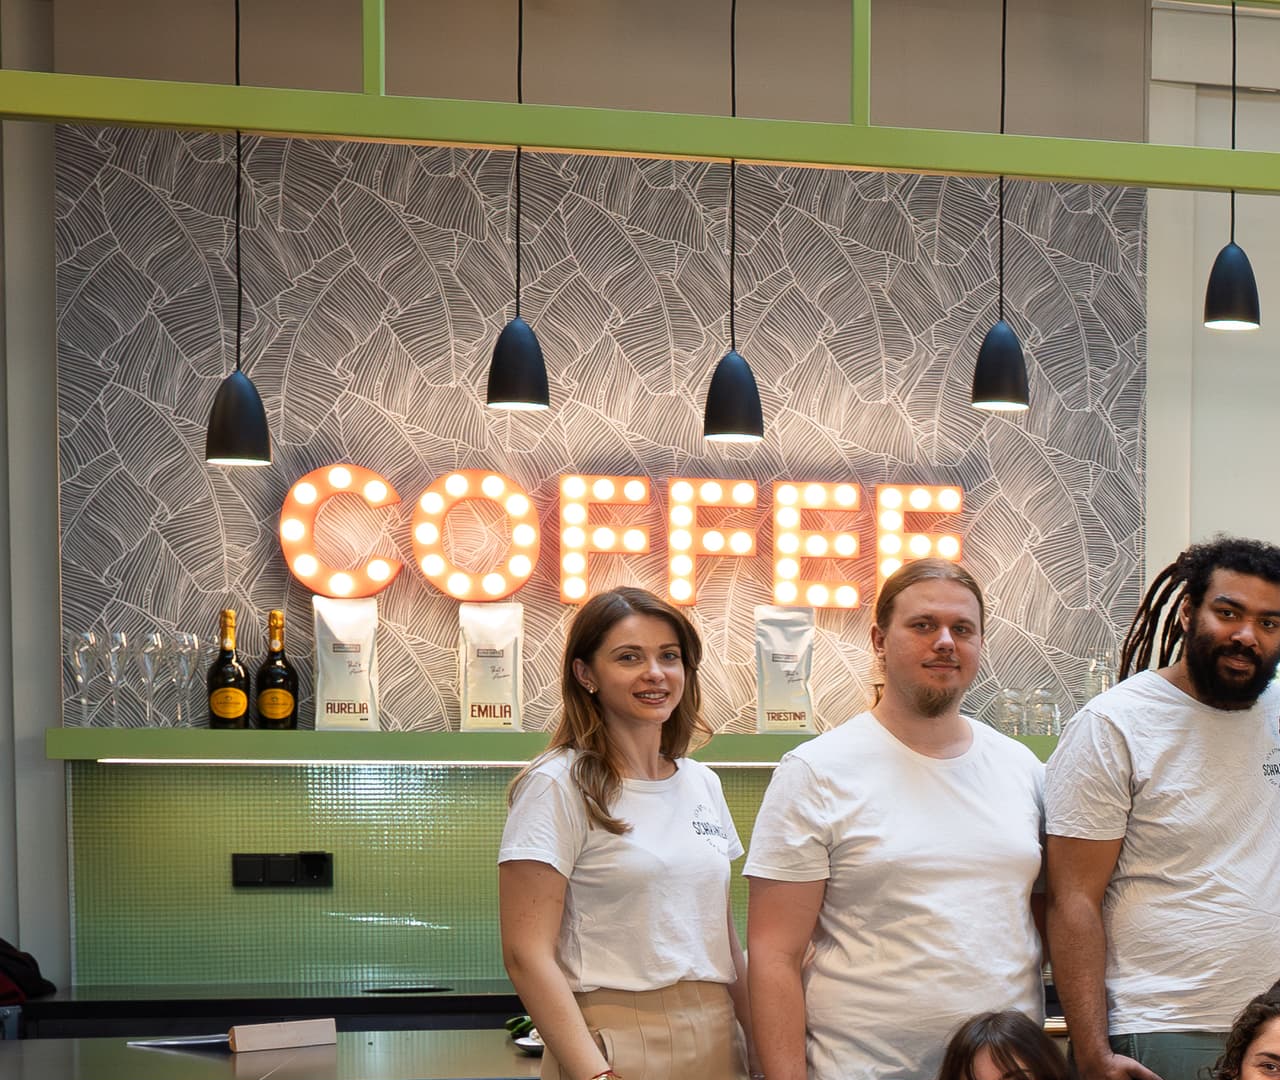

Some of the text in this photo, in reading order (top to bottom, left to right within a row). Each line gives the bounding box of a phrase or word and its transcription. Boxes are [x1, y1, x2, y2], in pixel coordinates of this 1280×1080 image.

[280, 464, 963, 609] COFFEE
[326, 703, 368, 713] AURELIA
[471, 704, 512, 718] EMILIA
[767, 712, 806, 721] TRIESTINA
